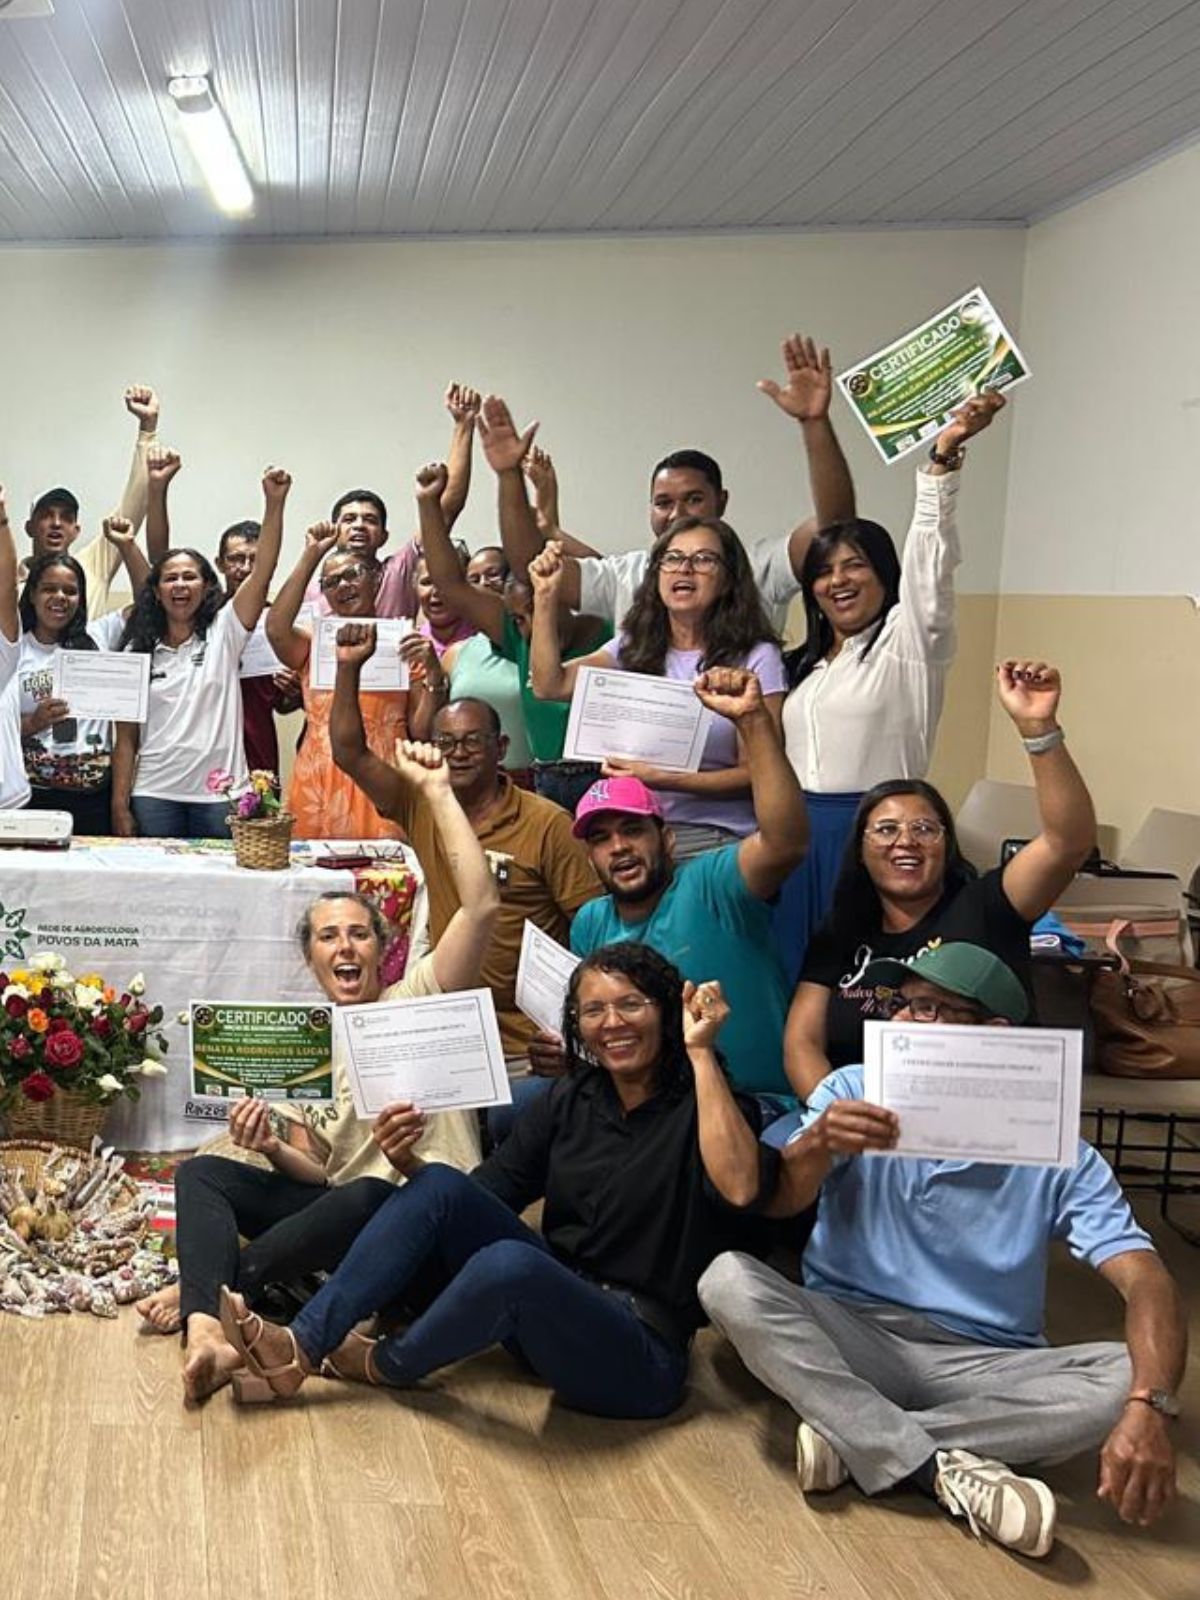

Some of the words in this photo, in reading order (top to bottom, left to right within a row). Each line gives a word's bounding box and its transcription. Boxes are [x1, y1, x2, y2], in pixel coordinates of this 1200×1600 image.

[869, 315, 961, 381] CERTIFICADO
[37, 924, 59, 932] REDE
[61, 925, 72, 933] DE
[37, 934, 80, 947] POVOS
[83, 936, 101, 947] DA
[104, 937, 139, 948] MATA
[215, 1009, 307, 1025] CERTIFICADO
[296, 1047, 330, 1056] LUCAS
